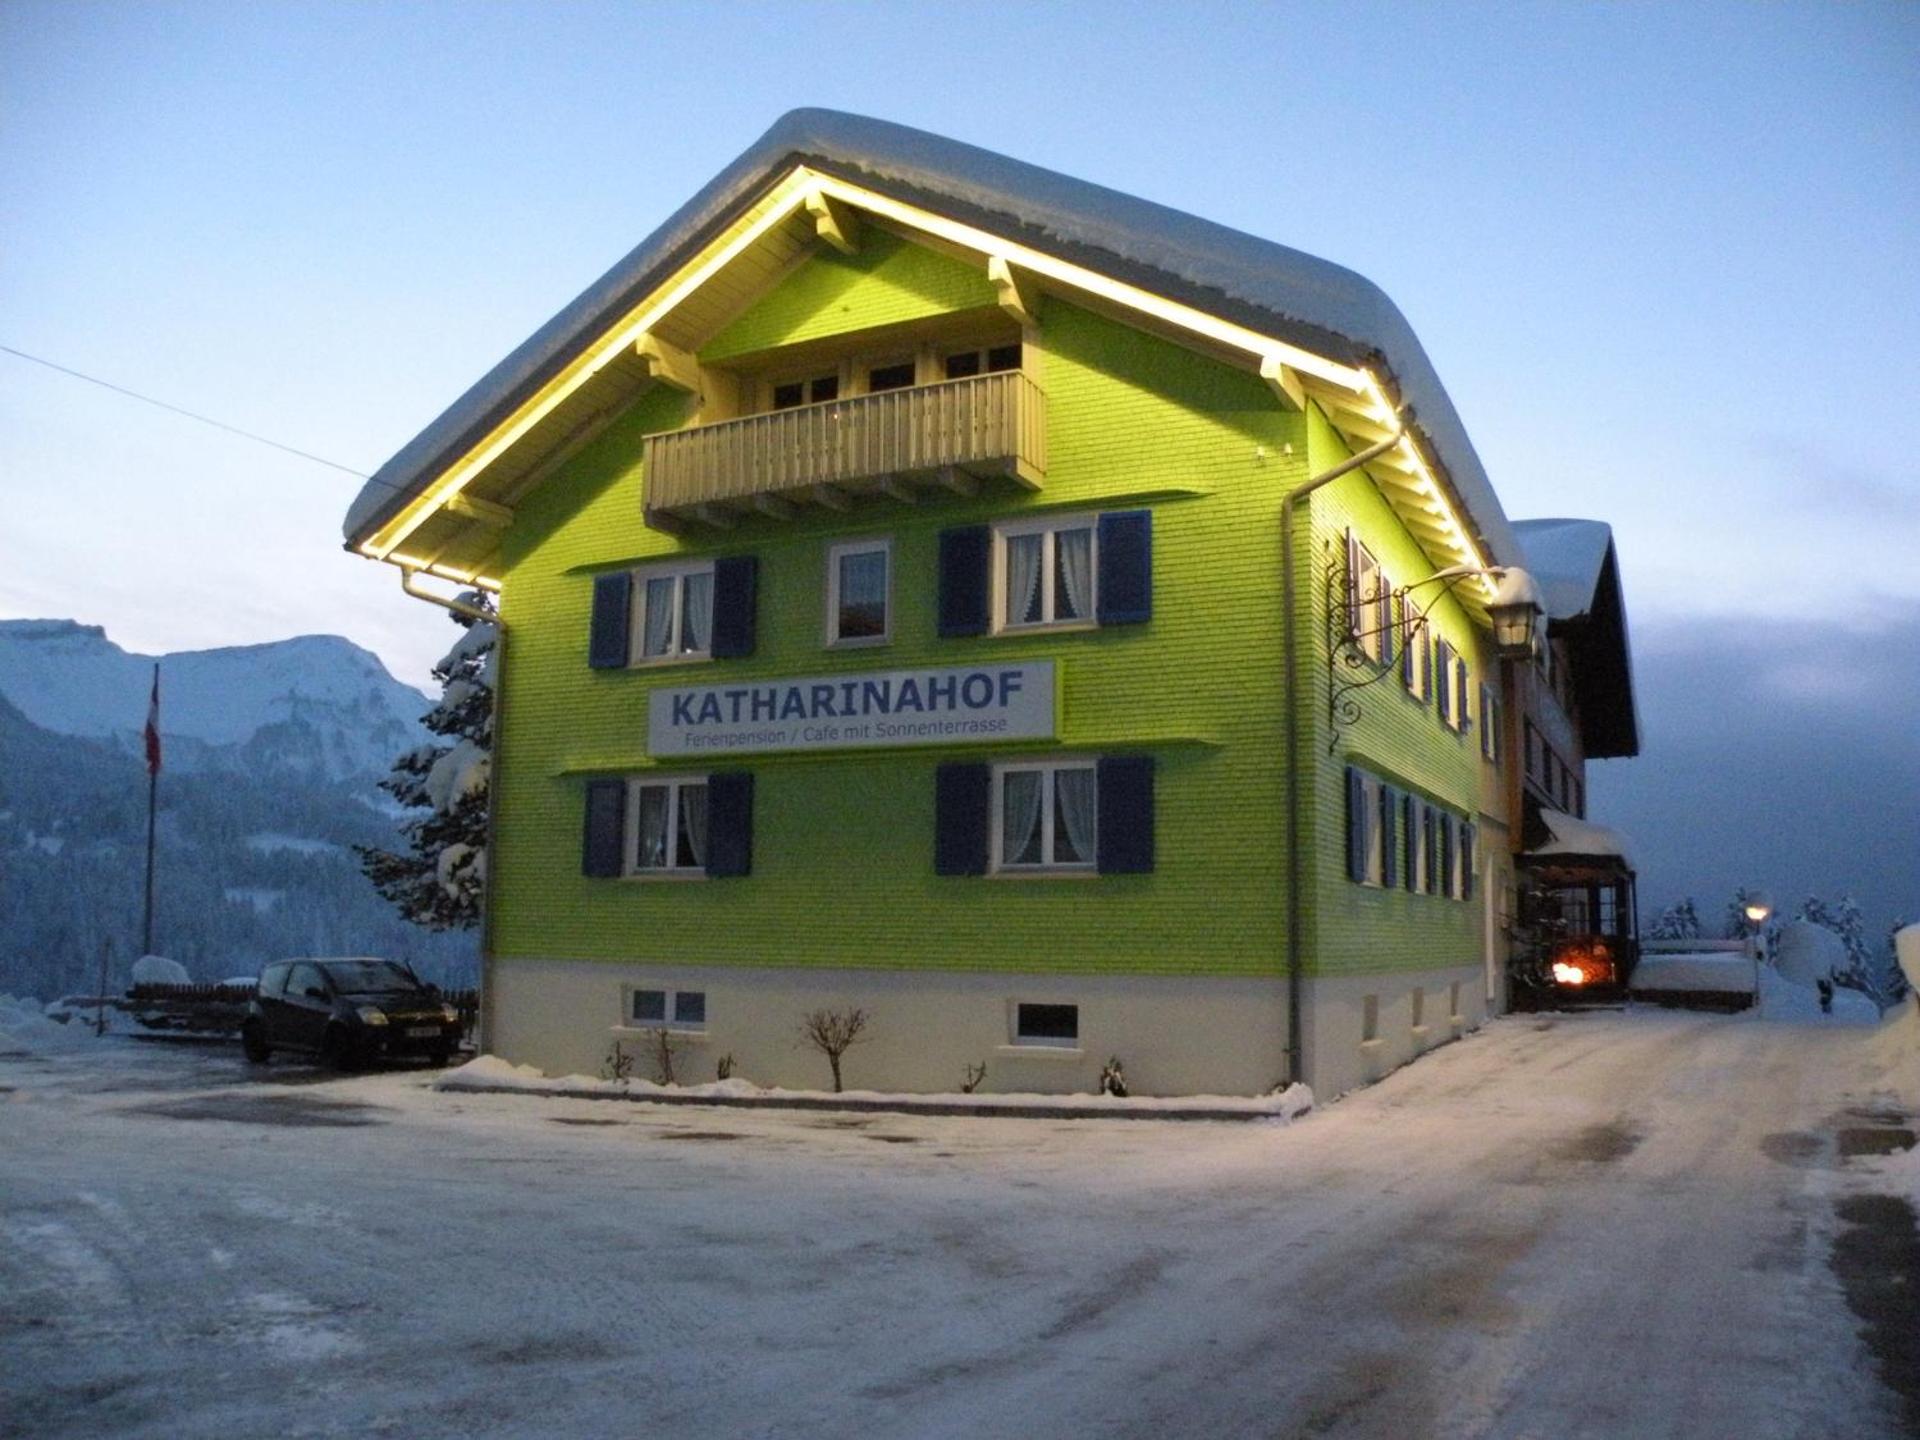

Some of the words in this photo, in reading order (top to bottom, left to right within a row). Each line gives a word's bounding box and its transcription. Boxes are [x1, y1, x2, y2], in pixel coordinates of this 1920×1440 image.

[672, 671, 1023, 726] KATHARINAHOF
[685, 729, 786, 747] Ferienpension
[844, 723, 870, 738] mit
[876, 718, 1007, 738] Sonnenterrasse
